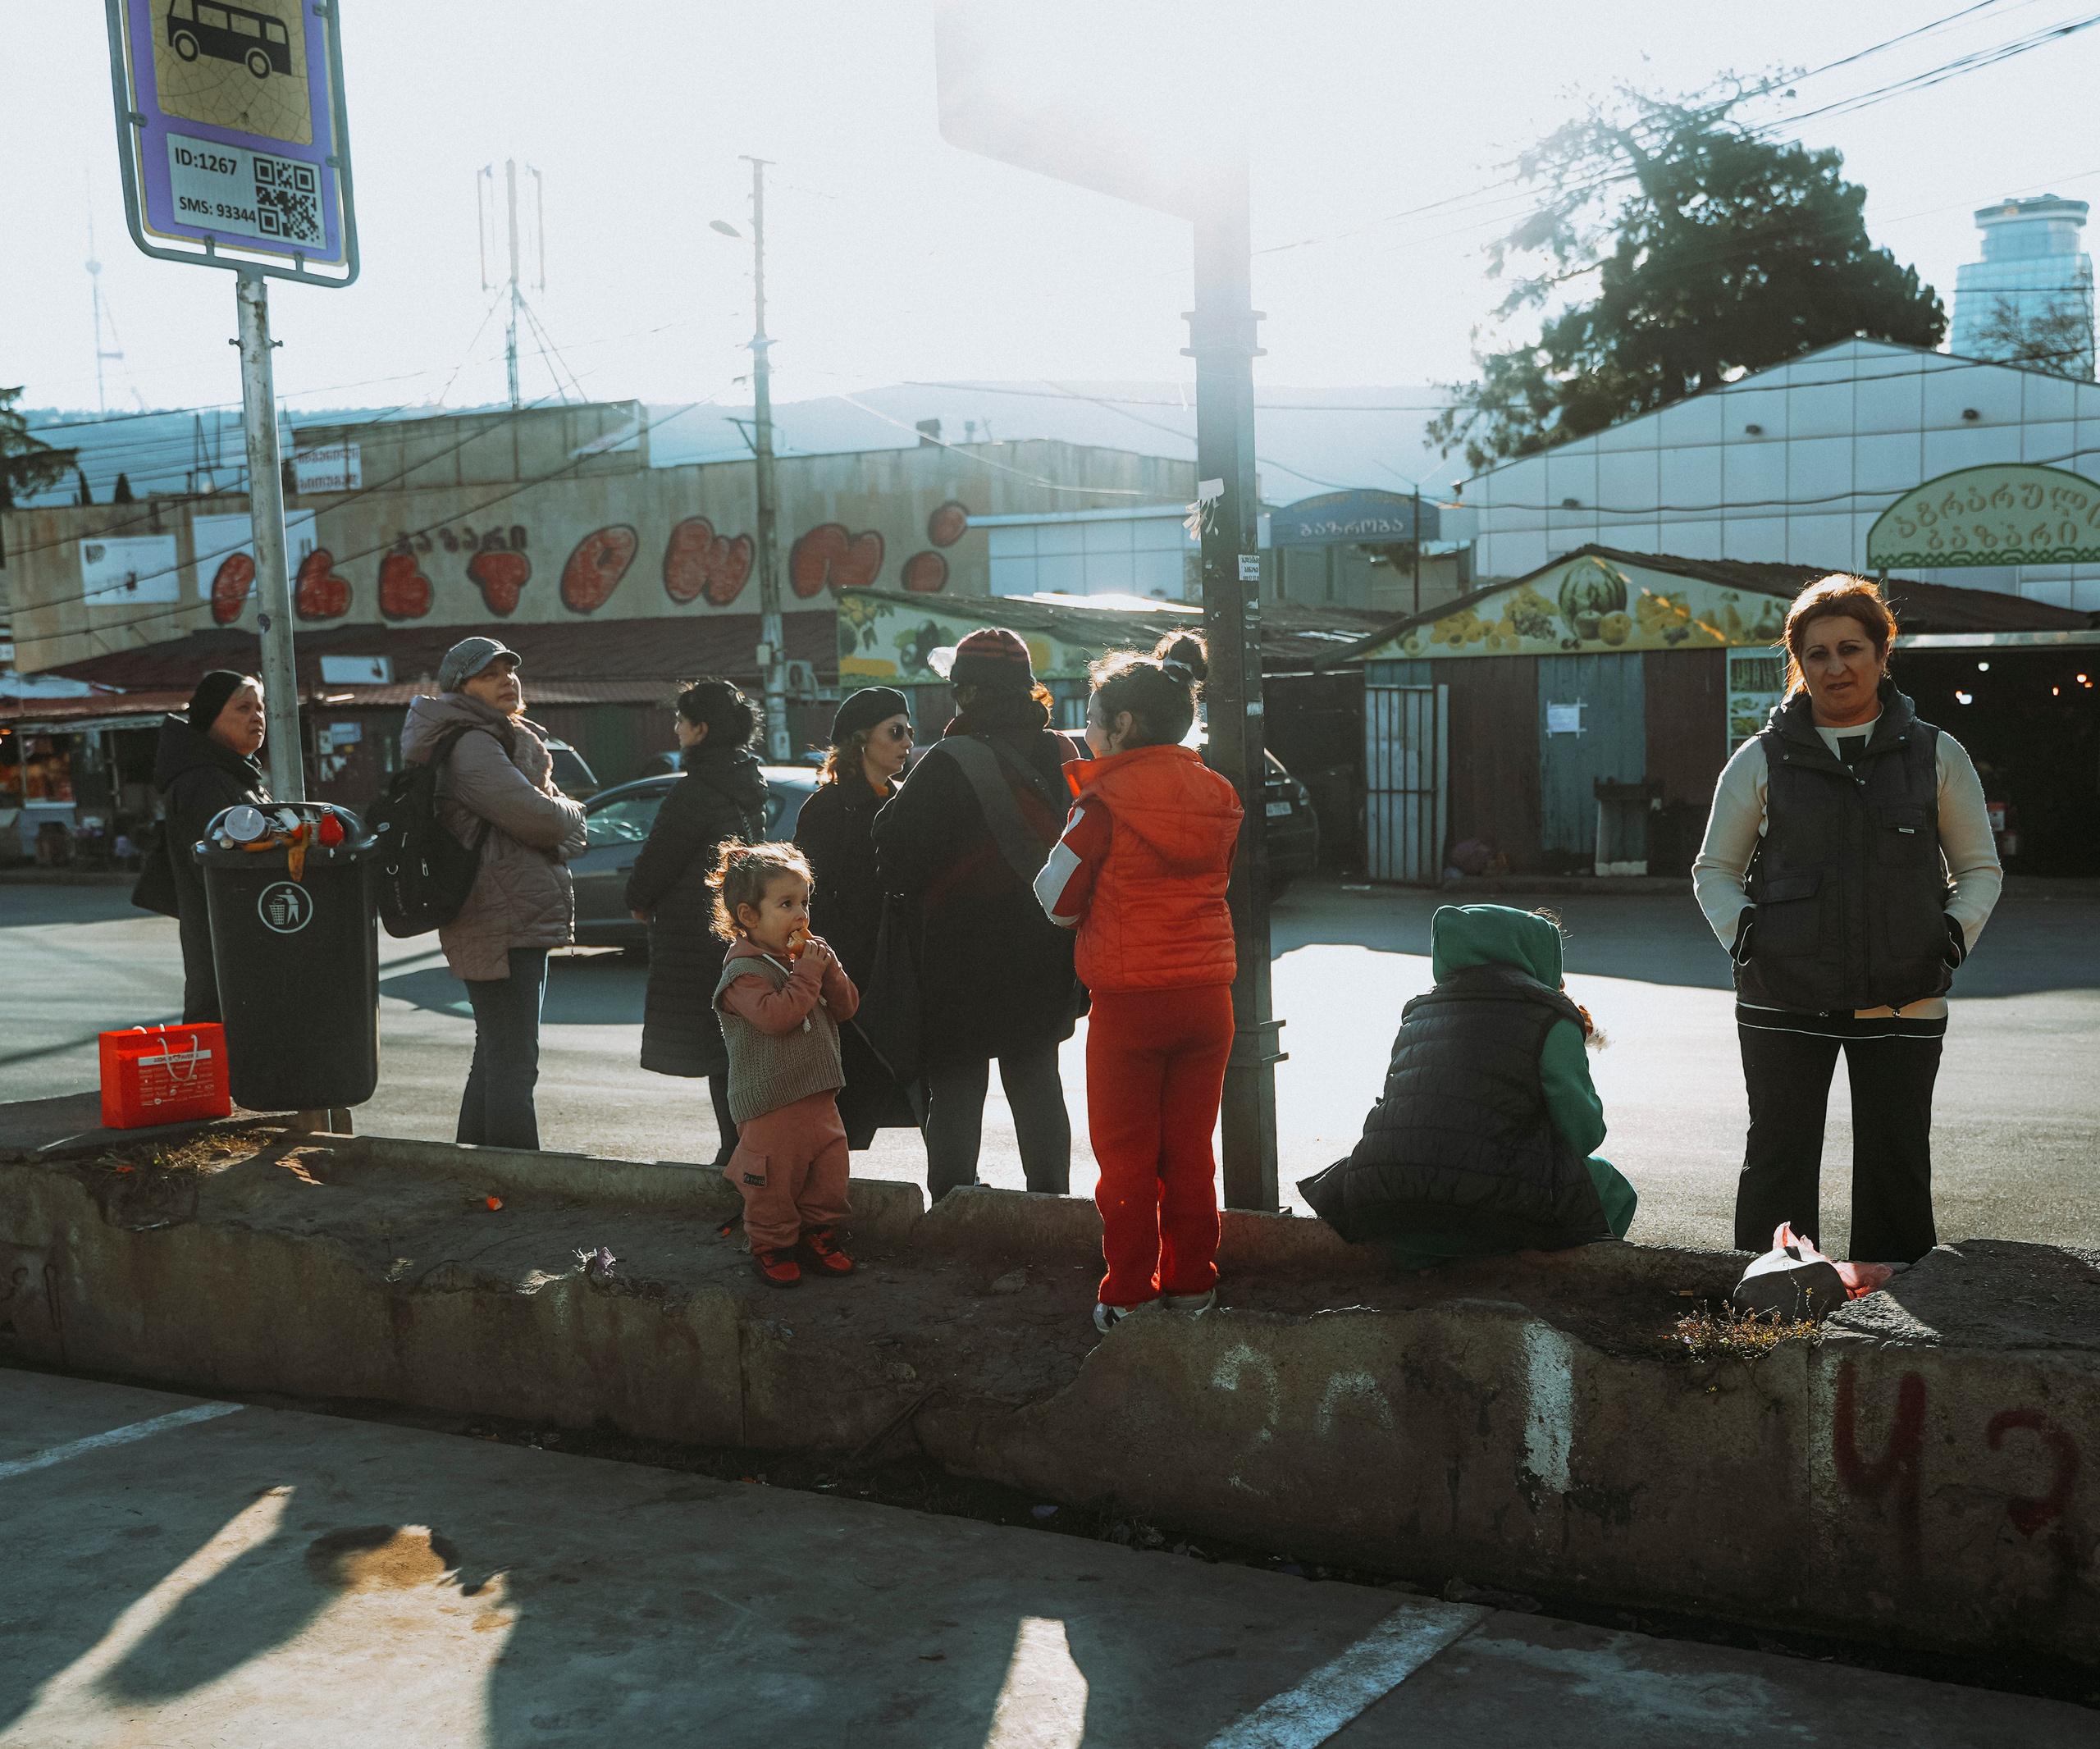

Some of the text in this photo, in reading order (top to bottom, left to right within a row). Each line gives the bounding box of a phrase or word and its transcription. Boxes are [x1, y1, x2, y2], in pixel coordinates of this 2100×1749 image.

[175, 147, 238, 176] ID:1267
[179, 196, 257, 223] SMS: 93344
[1299, 518, 1404, 537] ბაზრობა
[1928, 520, 2079, 550] ბაზარი
